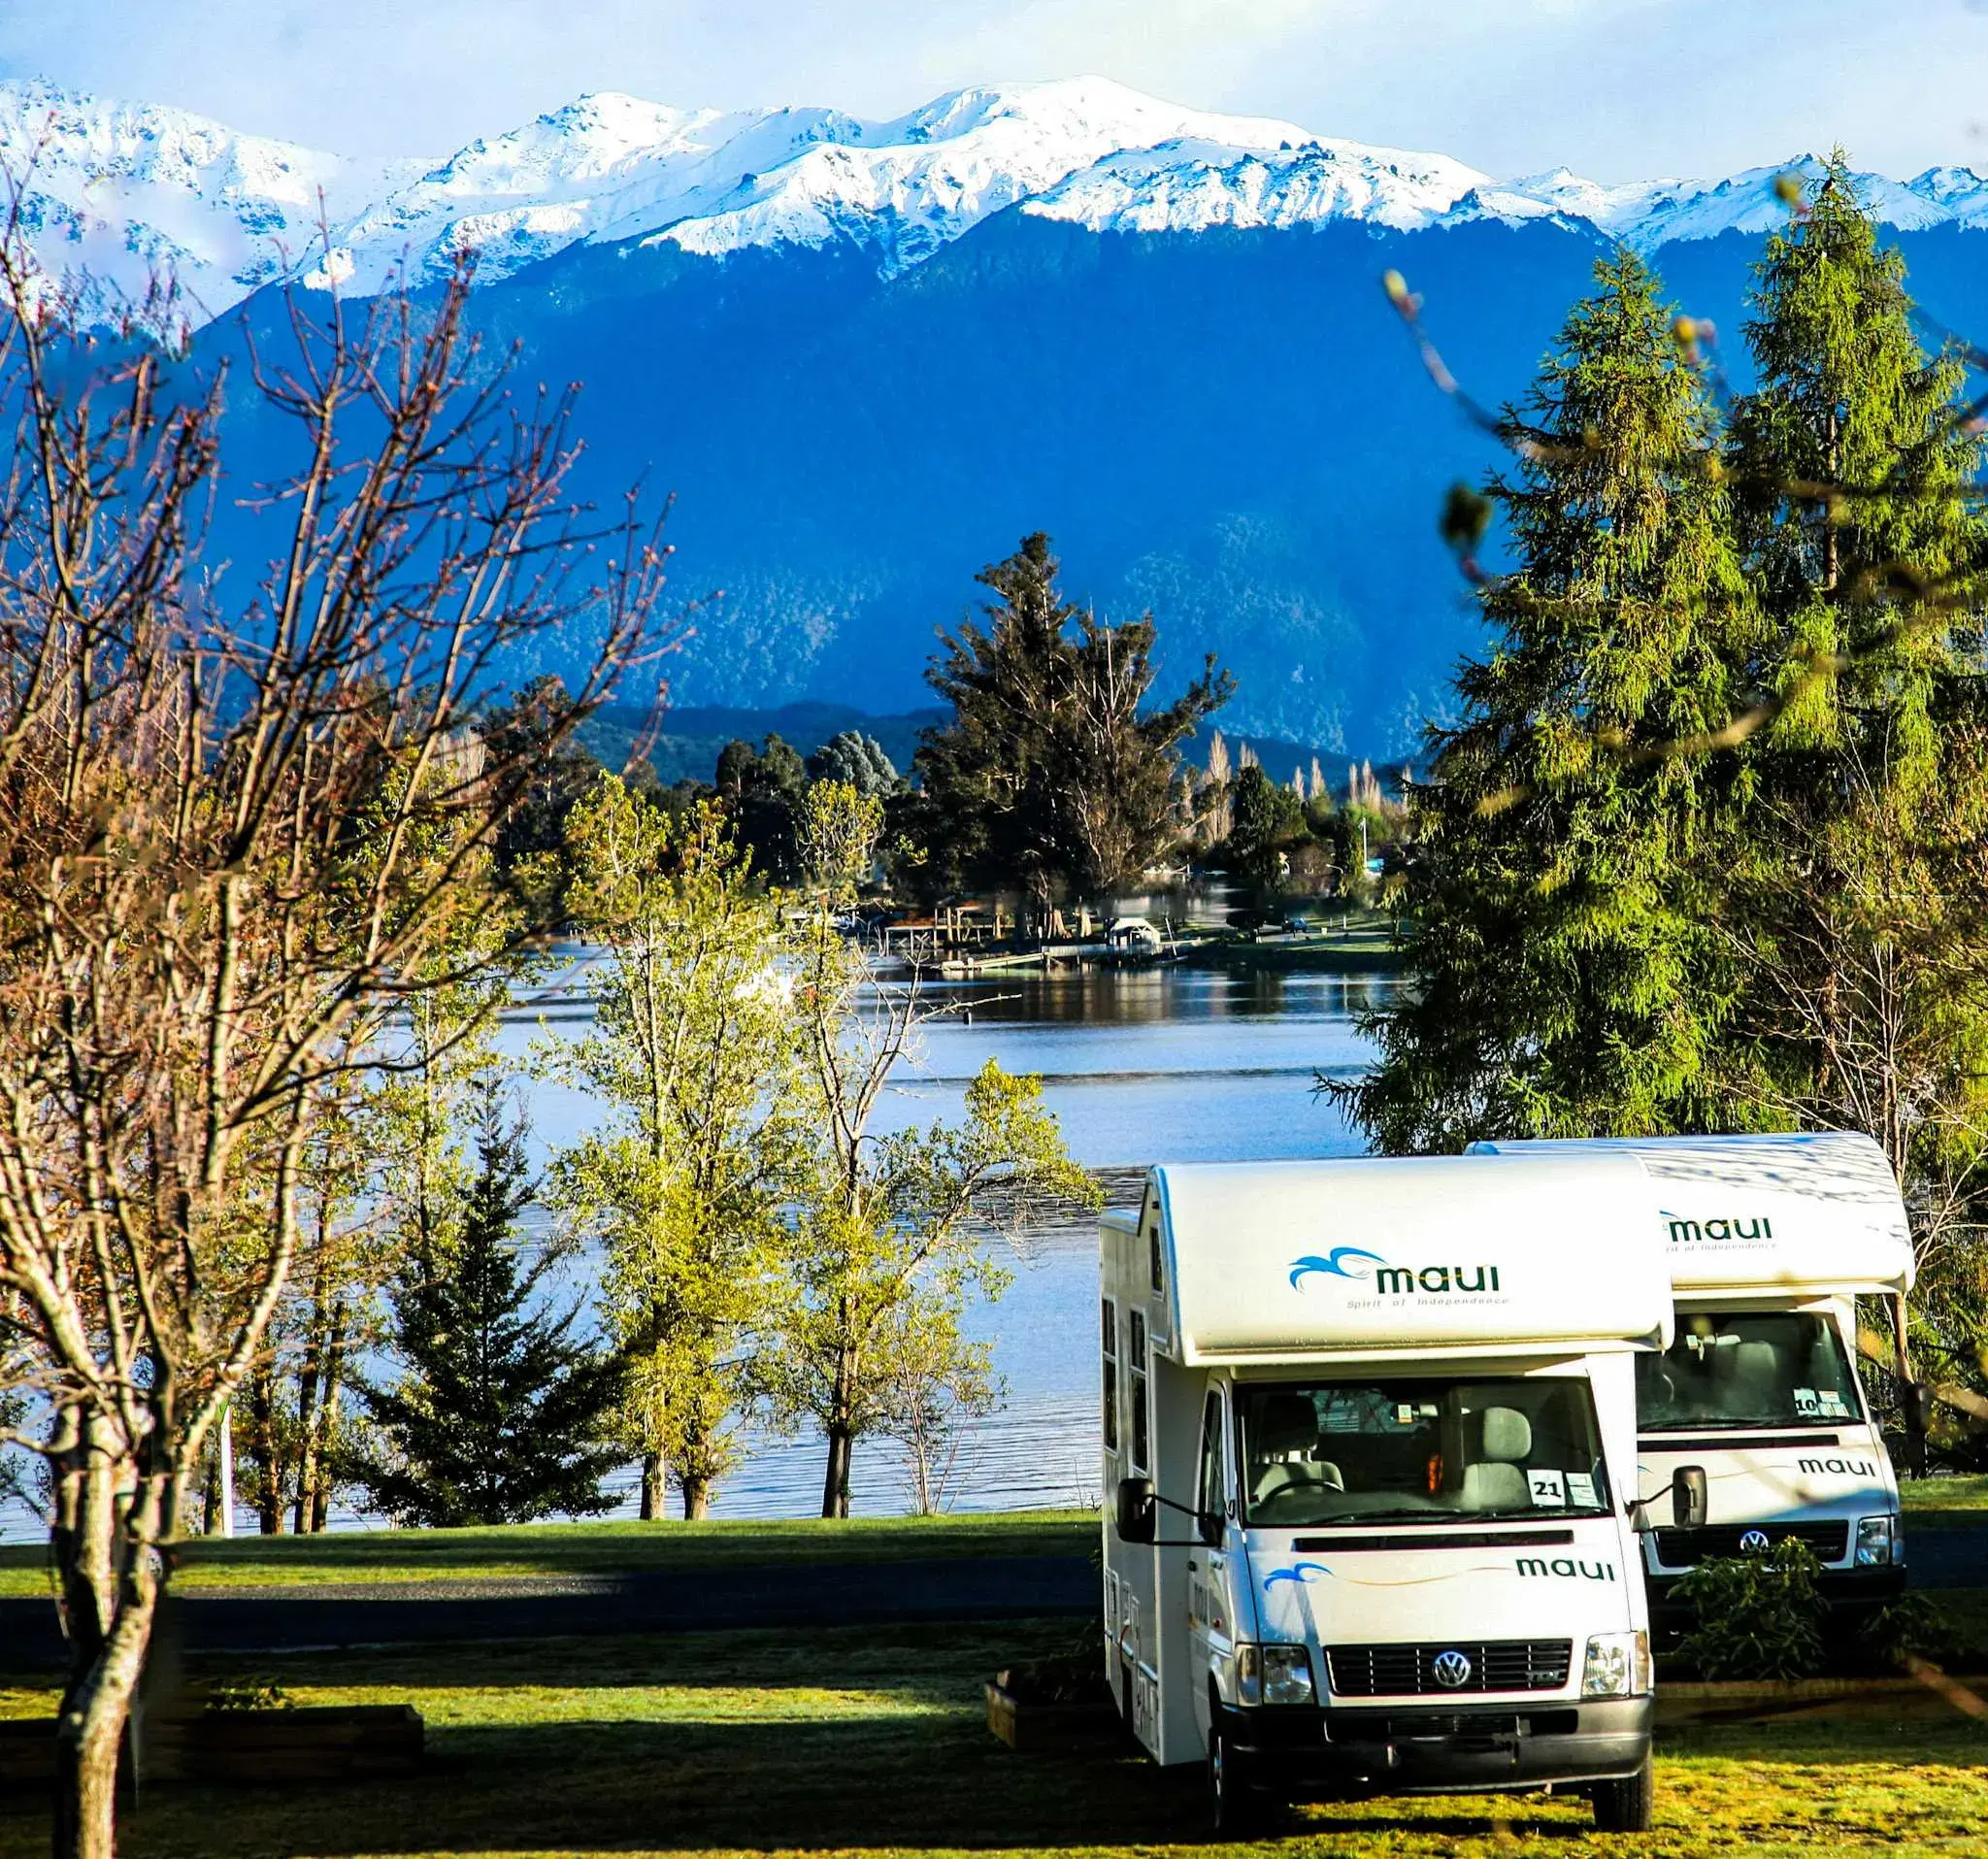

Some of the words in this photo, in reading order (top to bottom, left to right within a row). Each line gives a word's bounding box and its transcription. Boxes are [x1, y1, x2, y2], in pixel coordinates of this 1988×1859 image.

[1669, 1217, 1772, 1242] maui
[1376, 1266, 1500, 1294] maui
[1347, 1299, 1381, 1310] Spirit
[1417, 1297, 1508, 1307] Independence
[1796, 1399, 1816, 1411] 10
[1798, 1459, 1876, 1477] maui
[1534, 1481, 1561, 1498] 21
[1515, 1559, 1615, 1581] maui
[1434, 1651, 1471, 1687] VW
